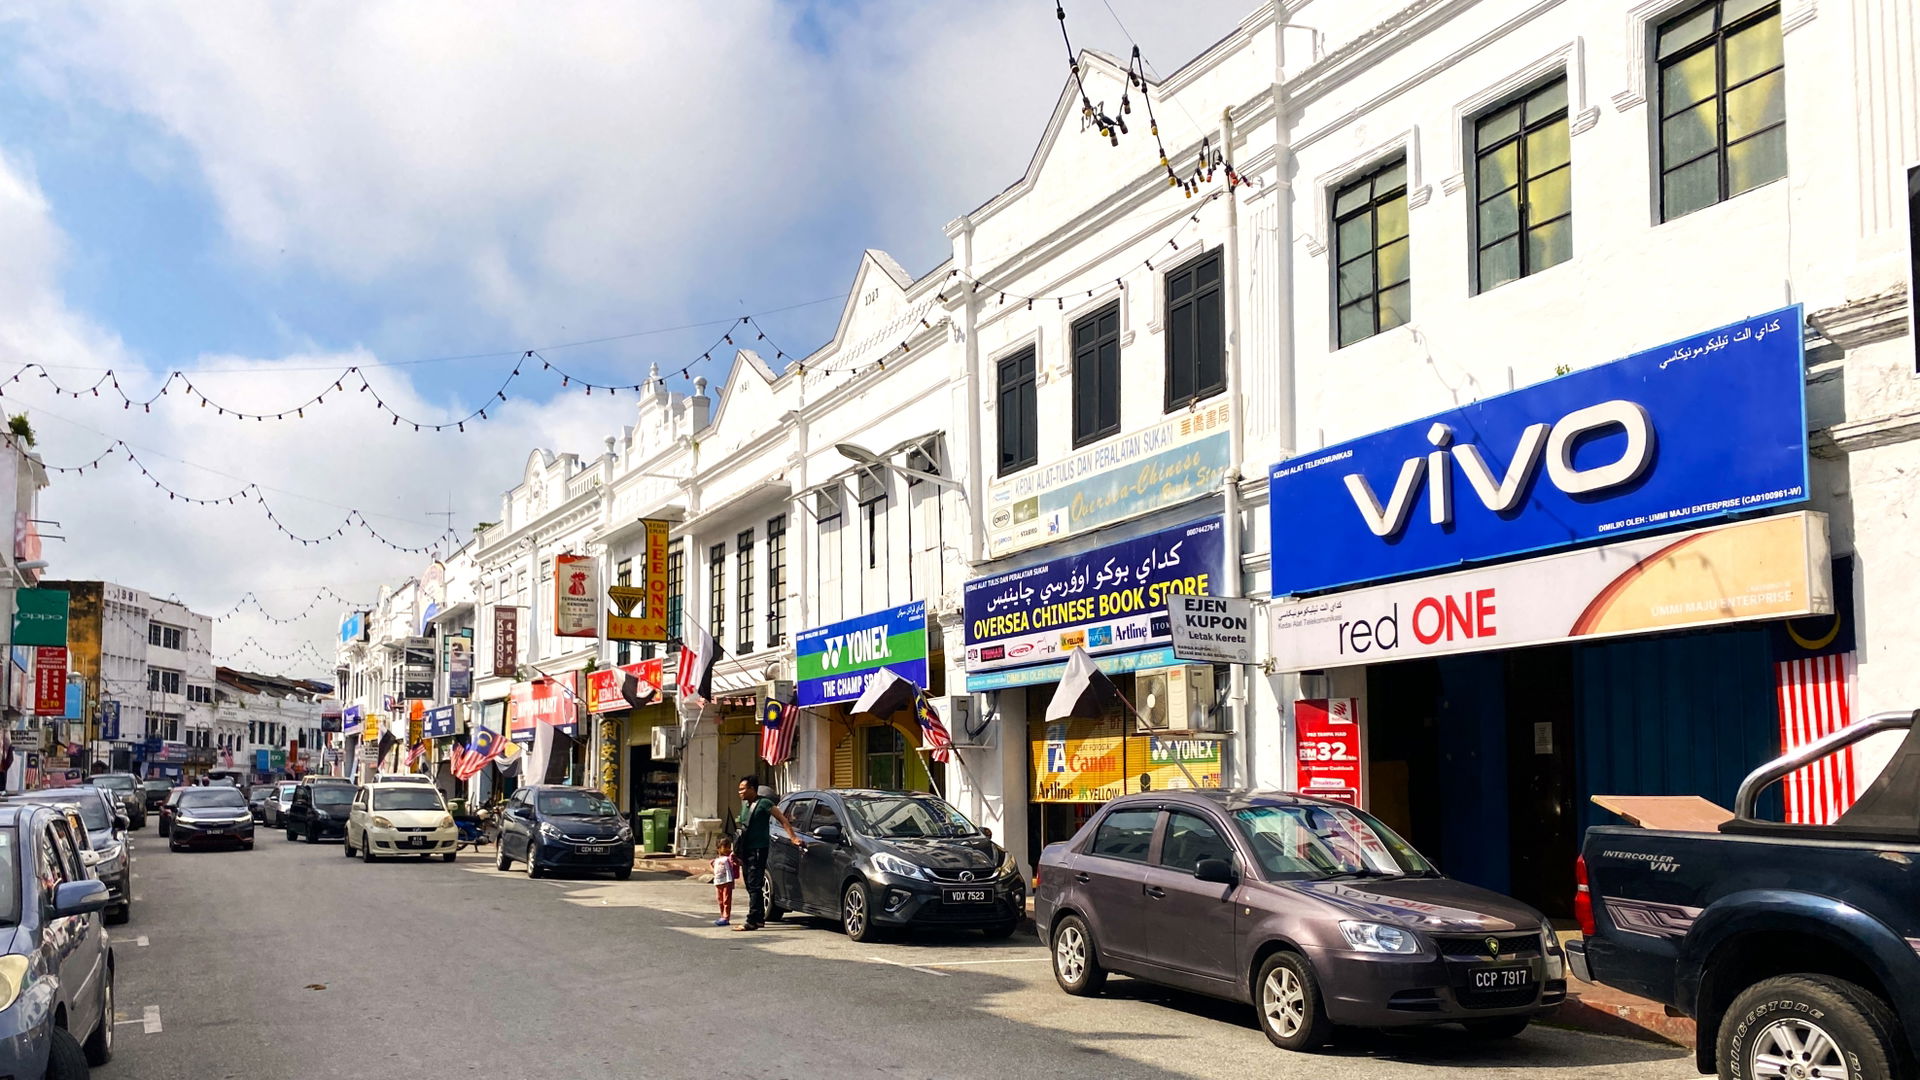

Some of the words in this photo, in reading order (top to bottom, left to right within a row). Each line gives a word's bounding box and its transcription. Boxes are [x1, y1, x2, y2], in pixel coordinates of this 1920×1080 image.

[1077, 453, 1093, 476] DAN
[1095, 435, 1140, 470] PERALATAN
[1144, 423, 1173, 453] SUKAN
[1273, 469, 1289, 479] KEDAI
[1289, 464, 1304, 475] ALAT
[1305, 450, 1353, 469] TELEKOMUNIKASI
[1344, 399, 1653, 539] vivo
[1649, 511, 1668, 523] UMMI
[1669, 507, 1690, 518] MAJU
[1692, 498, 1740, 514] ENTERPRISE
[652, 535, 664, 574] LEE
[650, 580, 665, 619] ONN
[974, 611, 1030, 640] OVERSEA
[1032, 597, 1095, 628] CHINESE
[1099, 587, 1145, 616] BOOK
[1149, 573, 1209, 607] STORE
[1185, 599, 1227, 613] EJEN
[1686, 599, 1718, 612] MAJU
[1721, 591, 1792, 608] ENTERPRISE
[1186, 615, 1247, 630] KUPON
[1339, 602, 1399, 655] red
[1412, 588, 1497, 645] ONE
[1116, 623, 1147, 641] Artline
[1189, 631, 1213, 641] Letak
[846, 624, 889, 665] YONEX
[822, 680, 836, 698] THE
[837, 676, 863, 696] CHAMP
[1174, 740, 1213, 760] YONEX
[1317, 742, 1346, 761] 32
[1069, 753, 1116, 772] Canon
[1039, 781, 1073, 800] Artline
[1089, 788, 1120, 800] YELLOW
[1603, 850, 1674, 863] INTERCOOLER
[1650, 862, 1681, 873] VNT
[968, 891, 985, 900] 7523
[1476, 972, 1498, 987] CCP
[1502, 970, 1527, 985] 7917
[1730, 1000, 1824, 1080] RIDGESTONE
